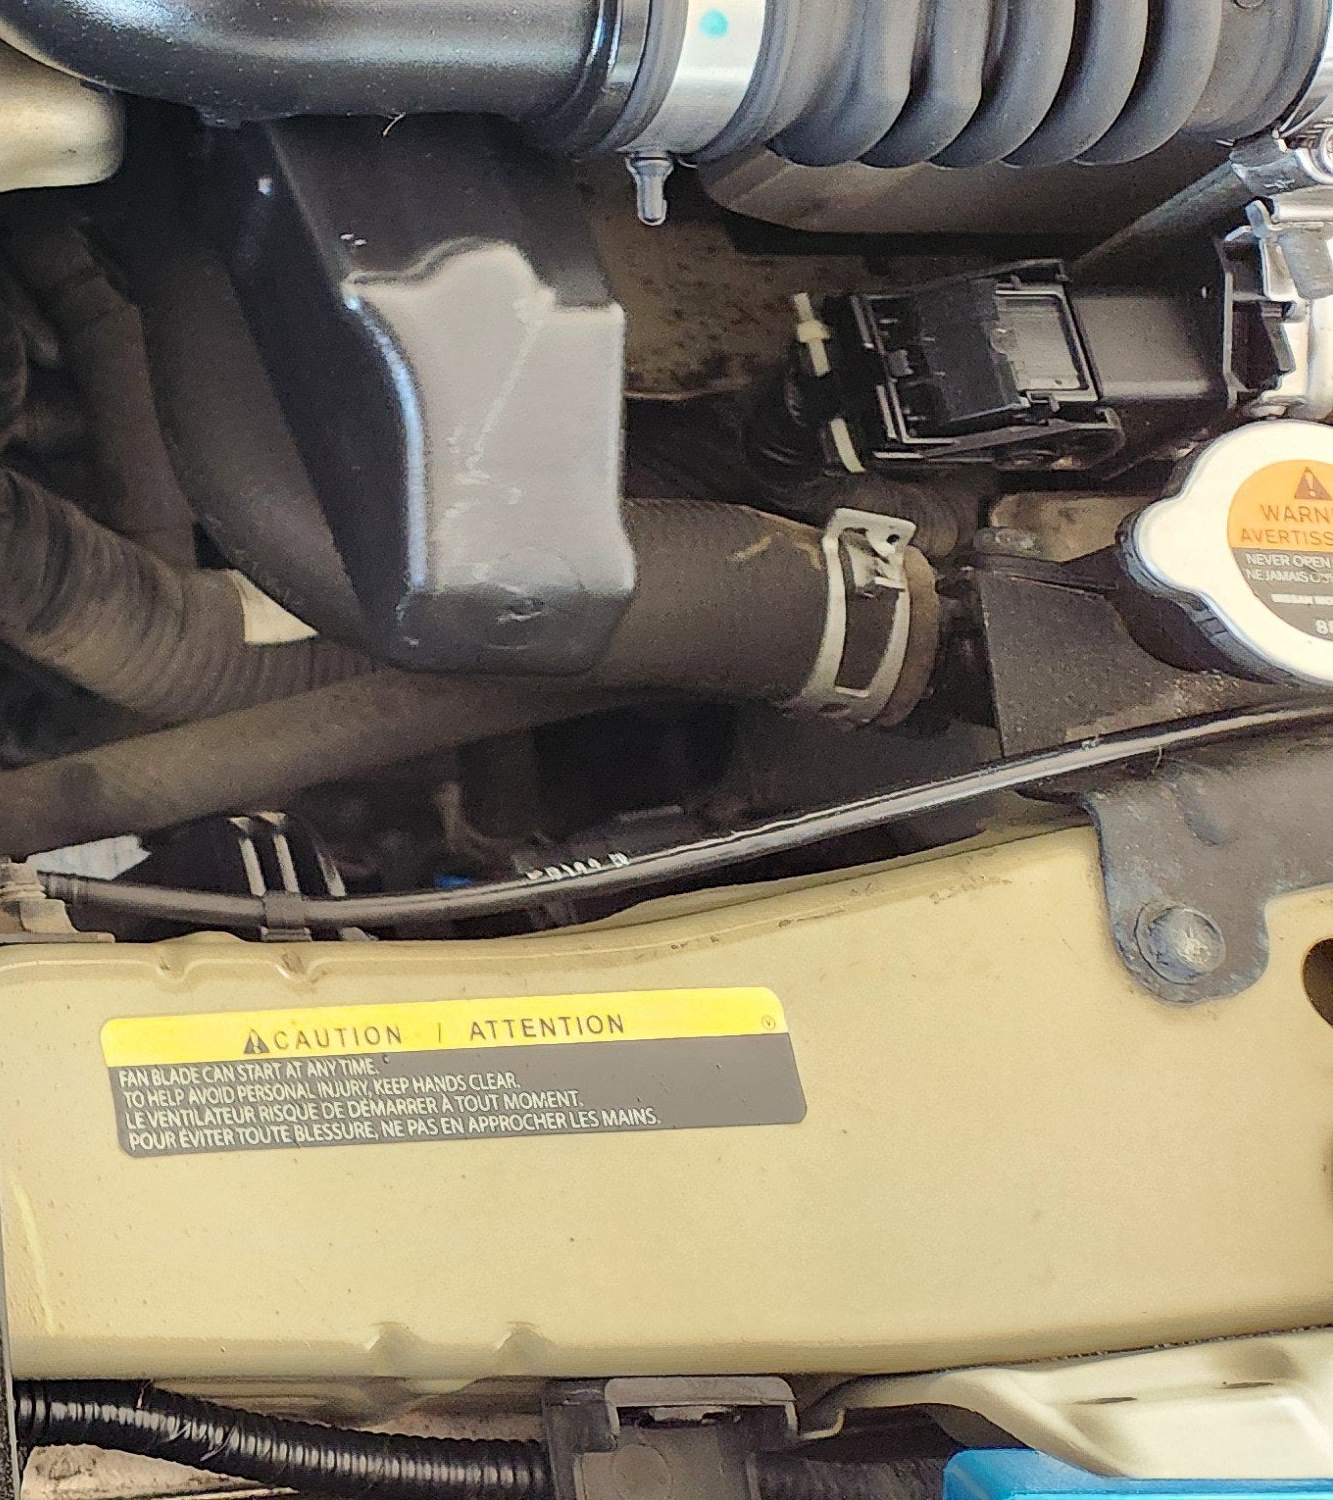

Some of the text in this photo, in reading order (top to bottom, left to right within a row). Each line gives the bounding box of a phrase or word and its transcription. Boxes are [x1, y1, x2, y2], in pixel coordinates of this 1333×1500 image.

[1245, 553, 1330, 569] NEVER OPEN
[1245, 569, 1265, 580] NE
[1265, 569, 1309, 583] JAMAIS
[273, 1024, 402, 1050] CAUTION
[469, 1013, 625, 1042] ATTENTION
[118, 1068, 149, 1087] FAN
[151, 1066, 200, 1086] BLADE
[202, 1064, 235, 1083] CAN
[236, 1062, 281, 1082] START
[286, 1061, 303, 1079] AT
[123, 1072, 520, 1108] TO HELP AVOID PERSONAL INJURY, KEEP HANDS CLEAR.
[125, 1089, 584, 1130] LE VENTILATEUR RISQUE DE DÉMARRER À TOUT MOMENT.
[129, 1107, 661, 1151] POUR ÉVITER TOUTE BLESSURE, NE PAS EN APPROCHER LES MAINS.
